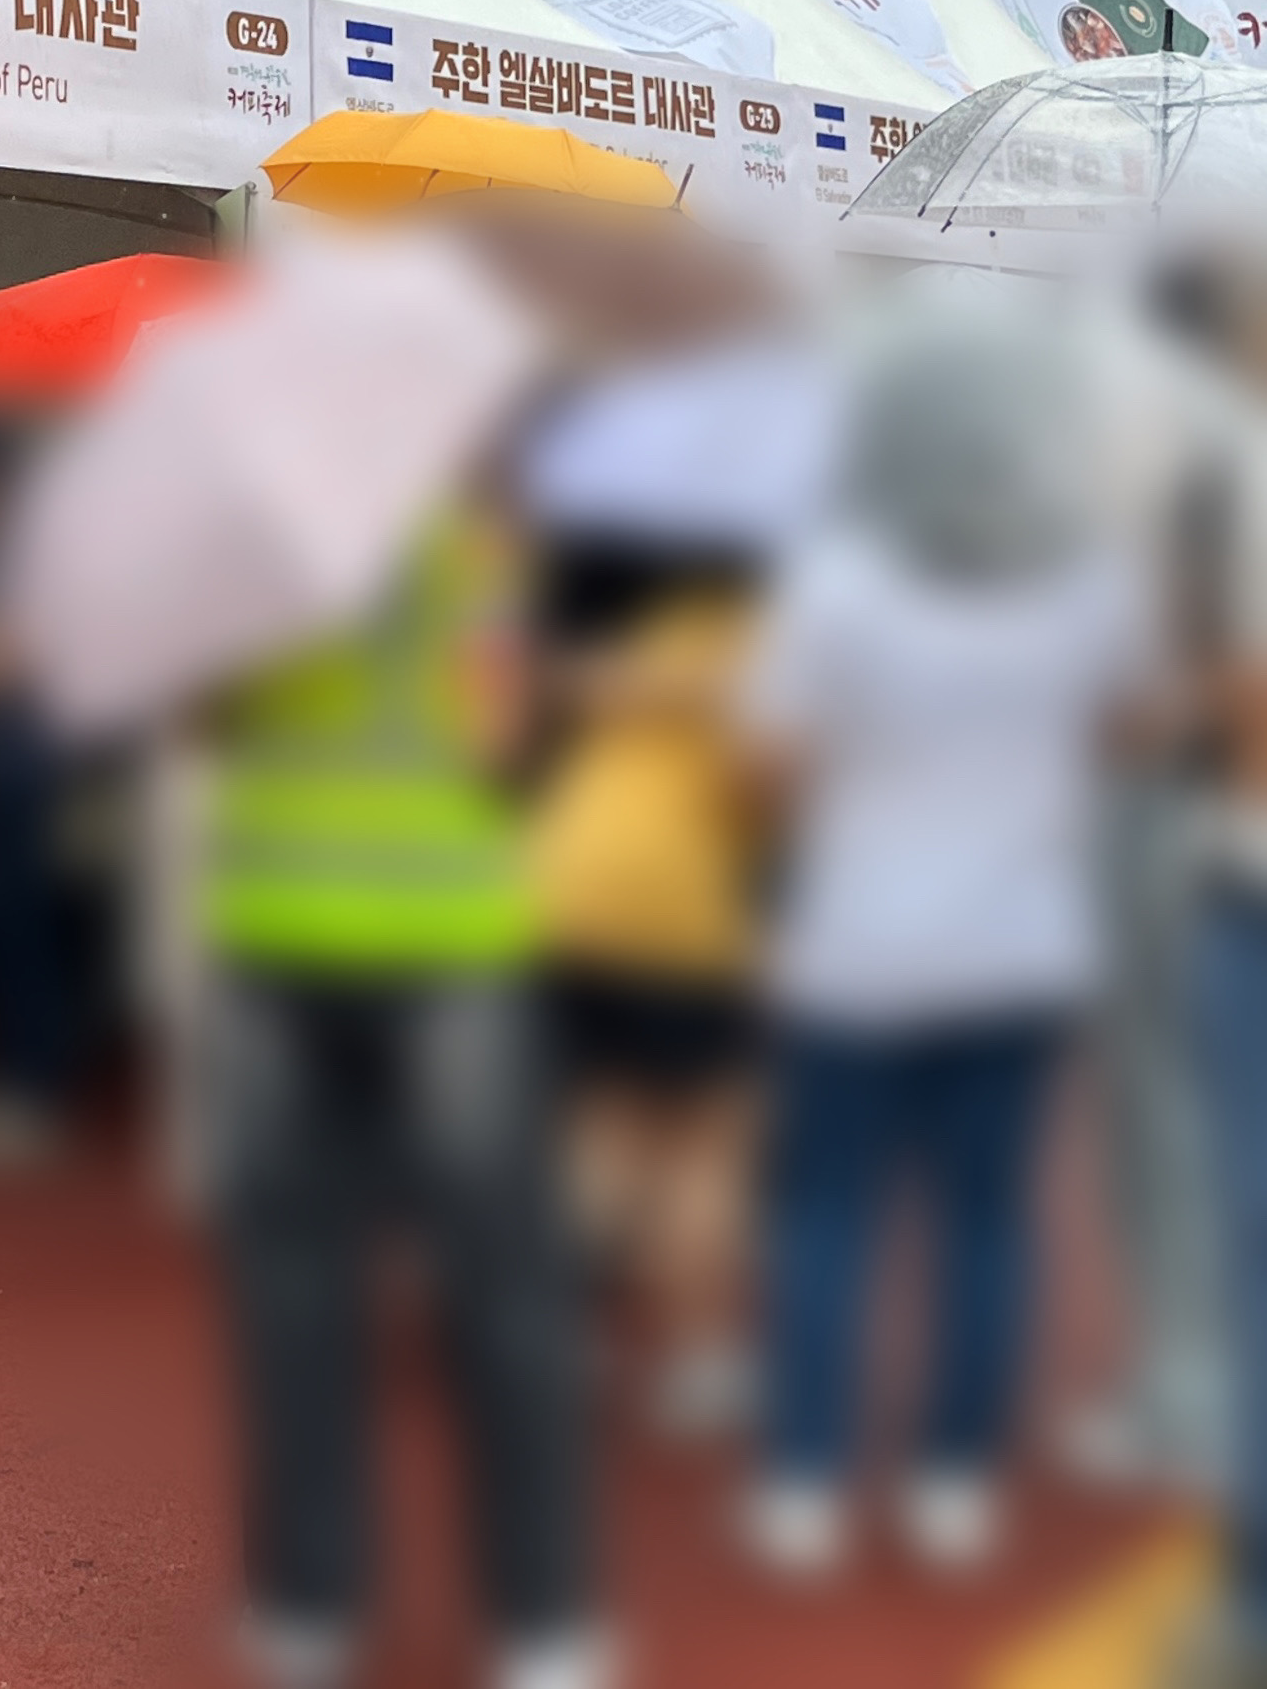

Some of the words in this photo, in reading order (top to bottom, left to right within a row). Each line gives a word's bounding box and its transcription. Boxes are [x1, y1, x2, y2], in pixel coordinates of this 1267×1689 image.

[237, 16, 278, 50] G-24
[17, 64, 69, 103] Peru
[431, 38, 491, 105] 주한
[499, 48, 636, 126] 엘살바도르
[641, 75, 717, 139] 대사관
[227, 84, 291, 126] 커피축제
[745, 104, 775, 131] G-25
